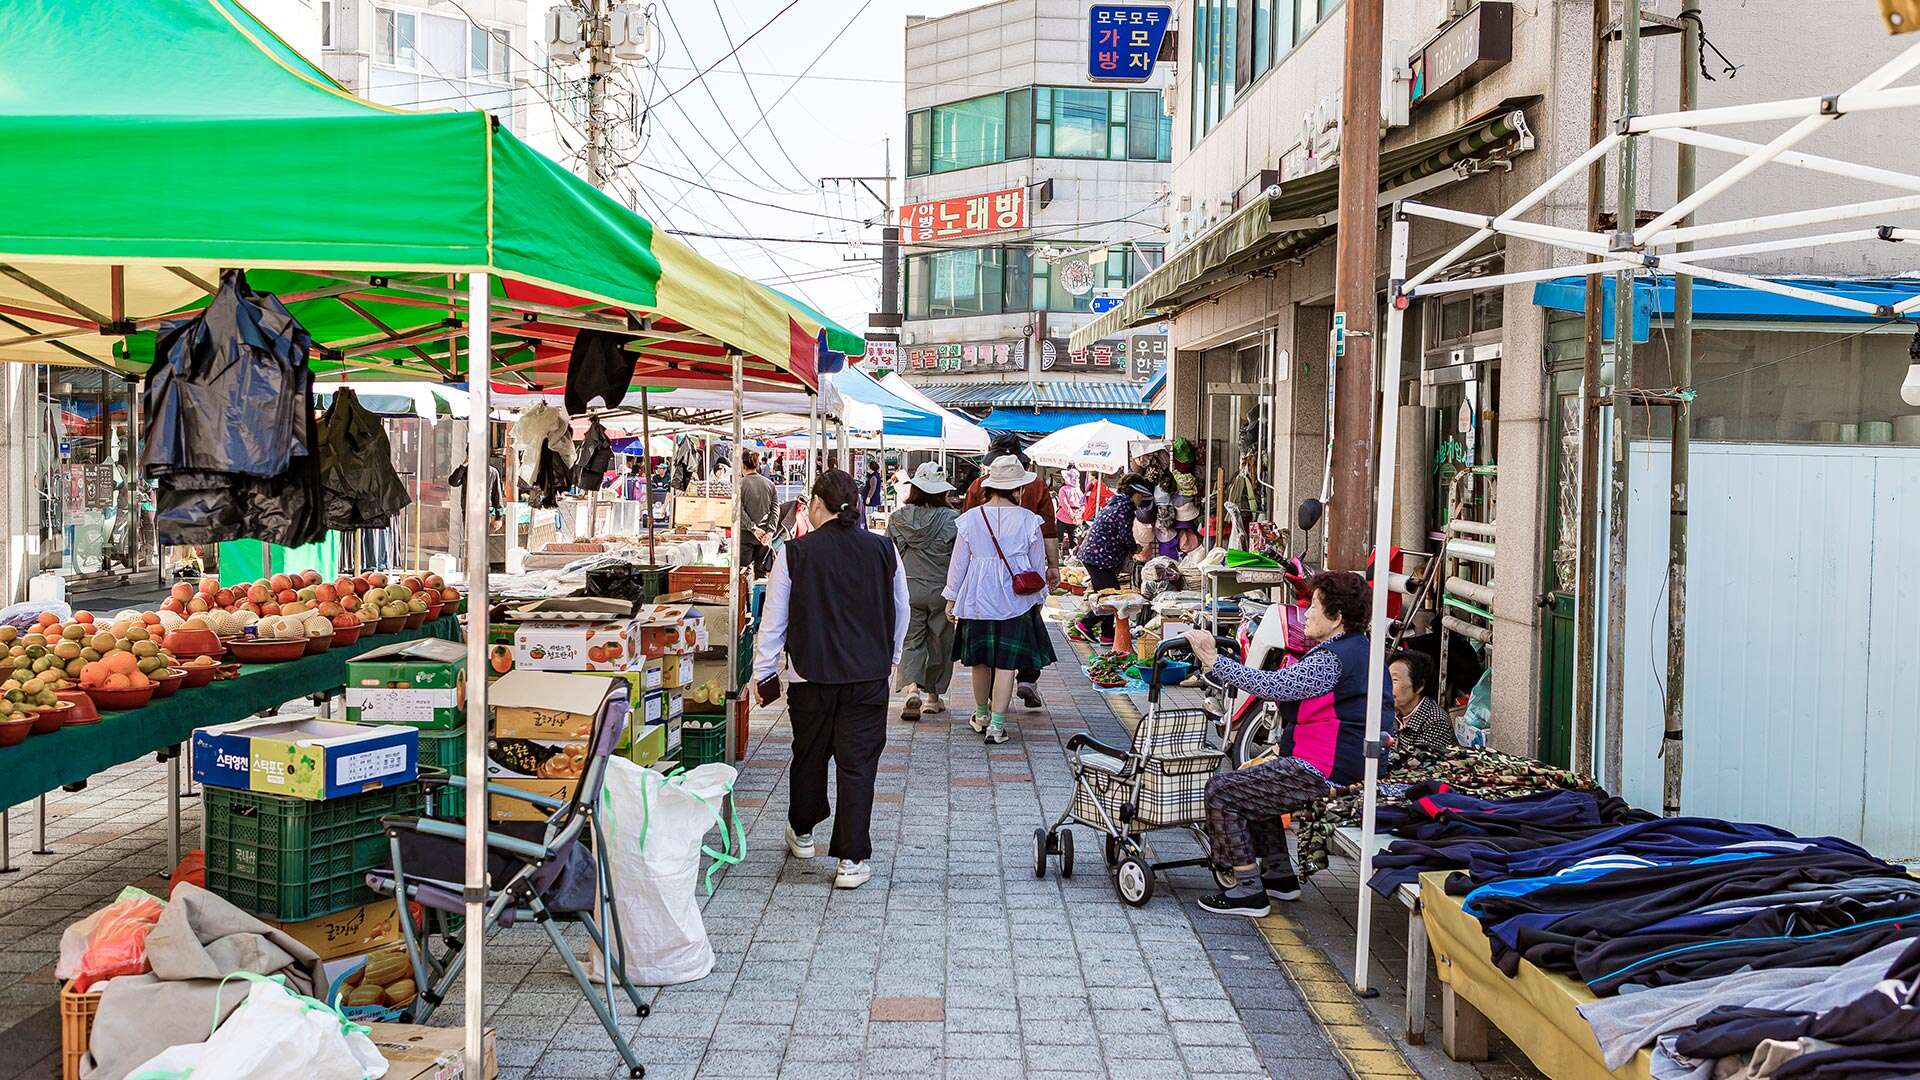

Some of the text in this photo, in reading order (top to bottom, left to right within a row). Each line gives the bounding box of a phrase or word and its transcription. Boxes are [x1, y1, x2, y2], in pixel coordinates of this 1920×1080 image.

[1097, 11, 1160, 26] 모두모두
[1098, 28, 1120, 70] 가방
[1128, 30, 1151, 71] 모자
[917, 191, 1021, 240] 아방궁 노래방
[1136, 340, 1167, 357] 우리
[869, 356, 892, 366] 식당
[911, 349, 938, 369] 단골
[216, 753, 249, 772] 스타영천
[253, 759, 285, 776] 스타포도
